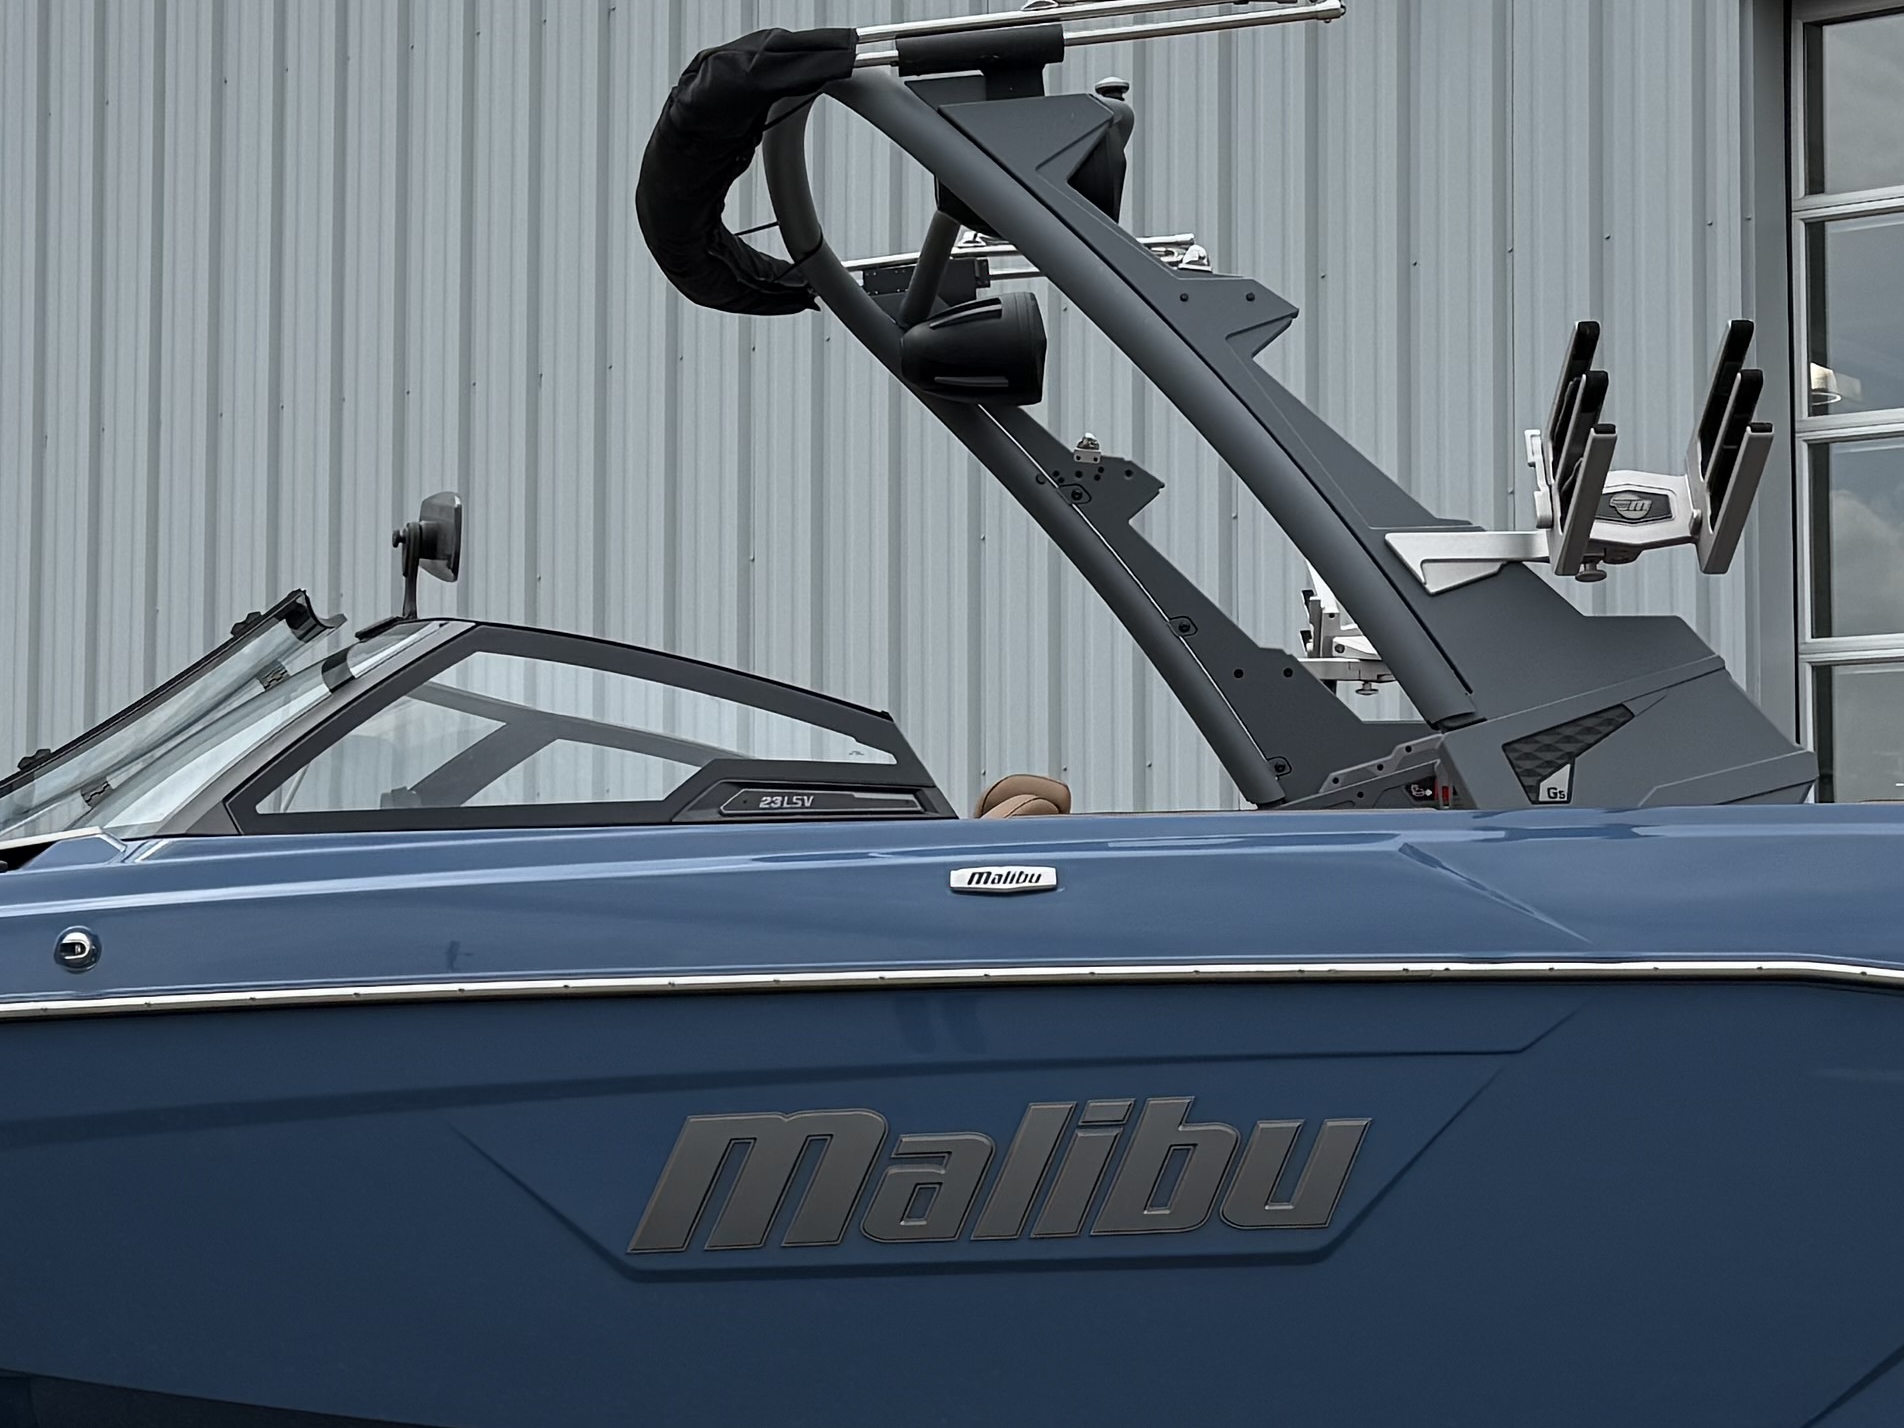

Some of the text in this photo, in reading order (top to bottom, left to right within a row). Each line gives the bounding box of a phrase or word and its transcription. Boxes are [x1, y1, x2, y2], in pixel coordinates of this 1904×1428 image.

[1547, 787, 1566, 800] G5
[759, 795, 814, 808] 23LSV
[967, 871, 1042, 886] Malibu
[627, 1096, 1373, 1254] Malibu
